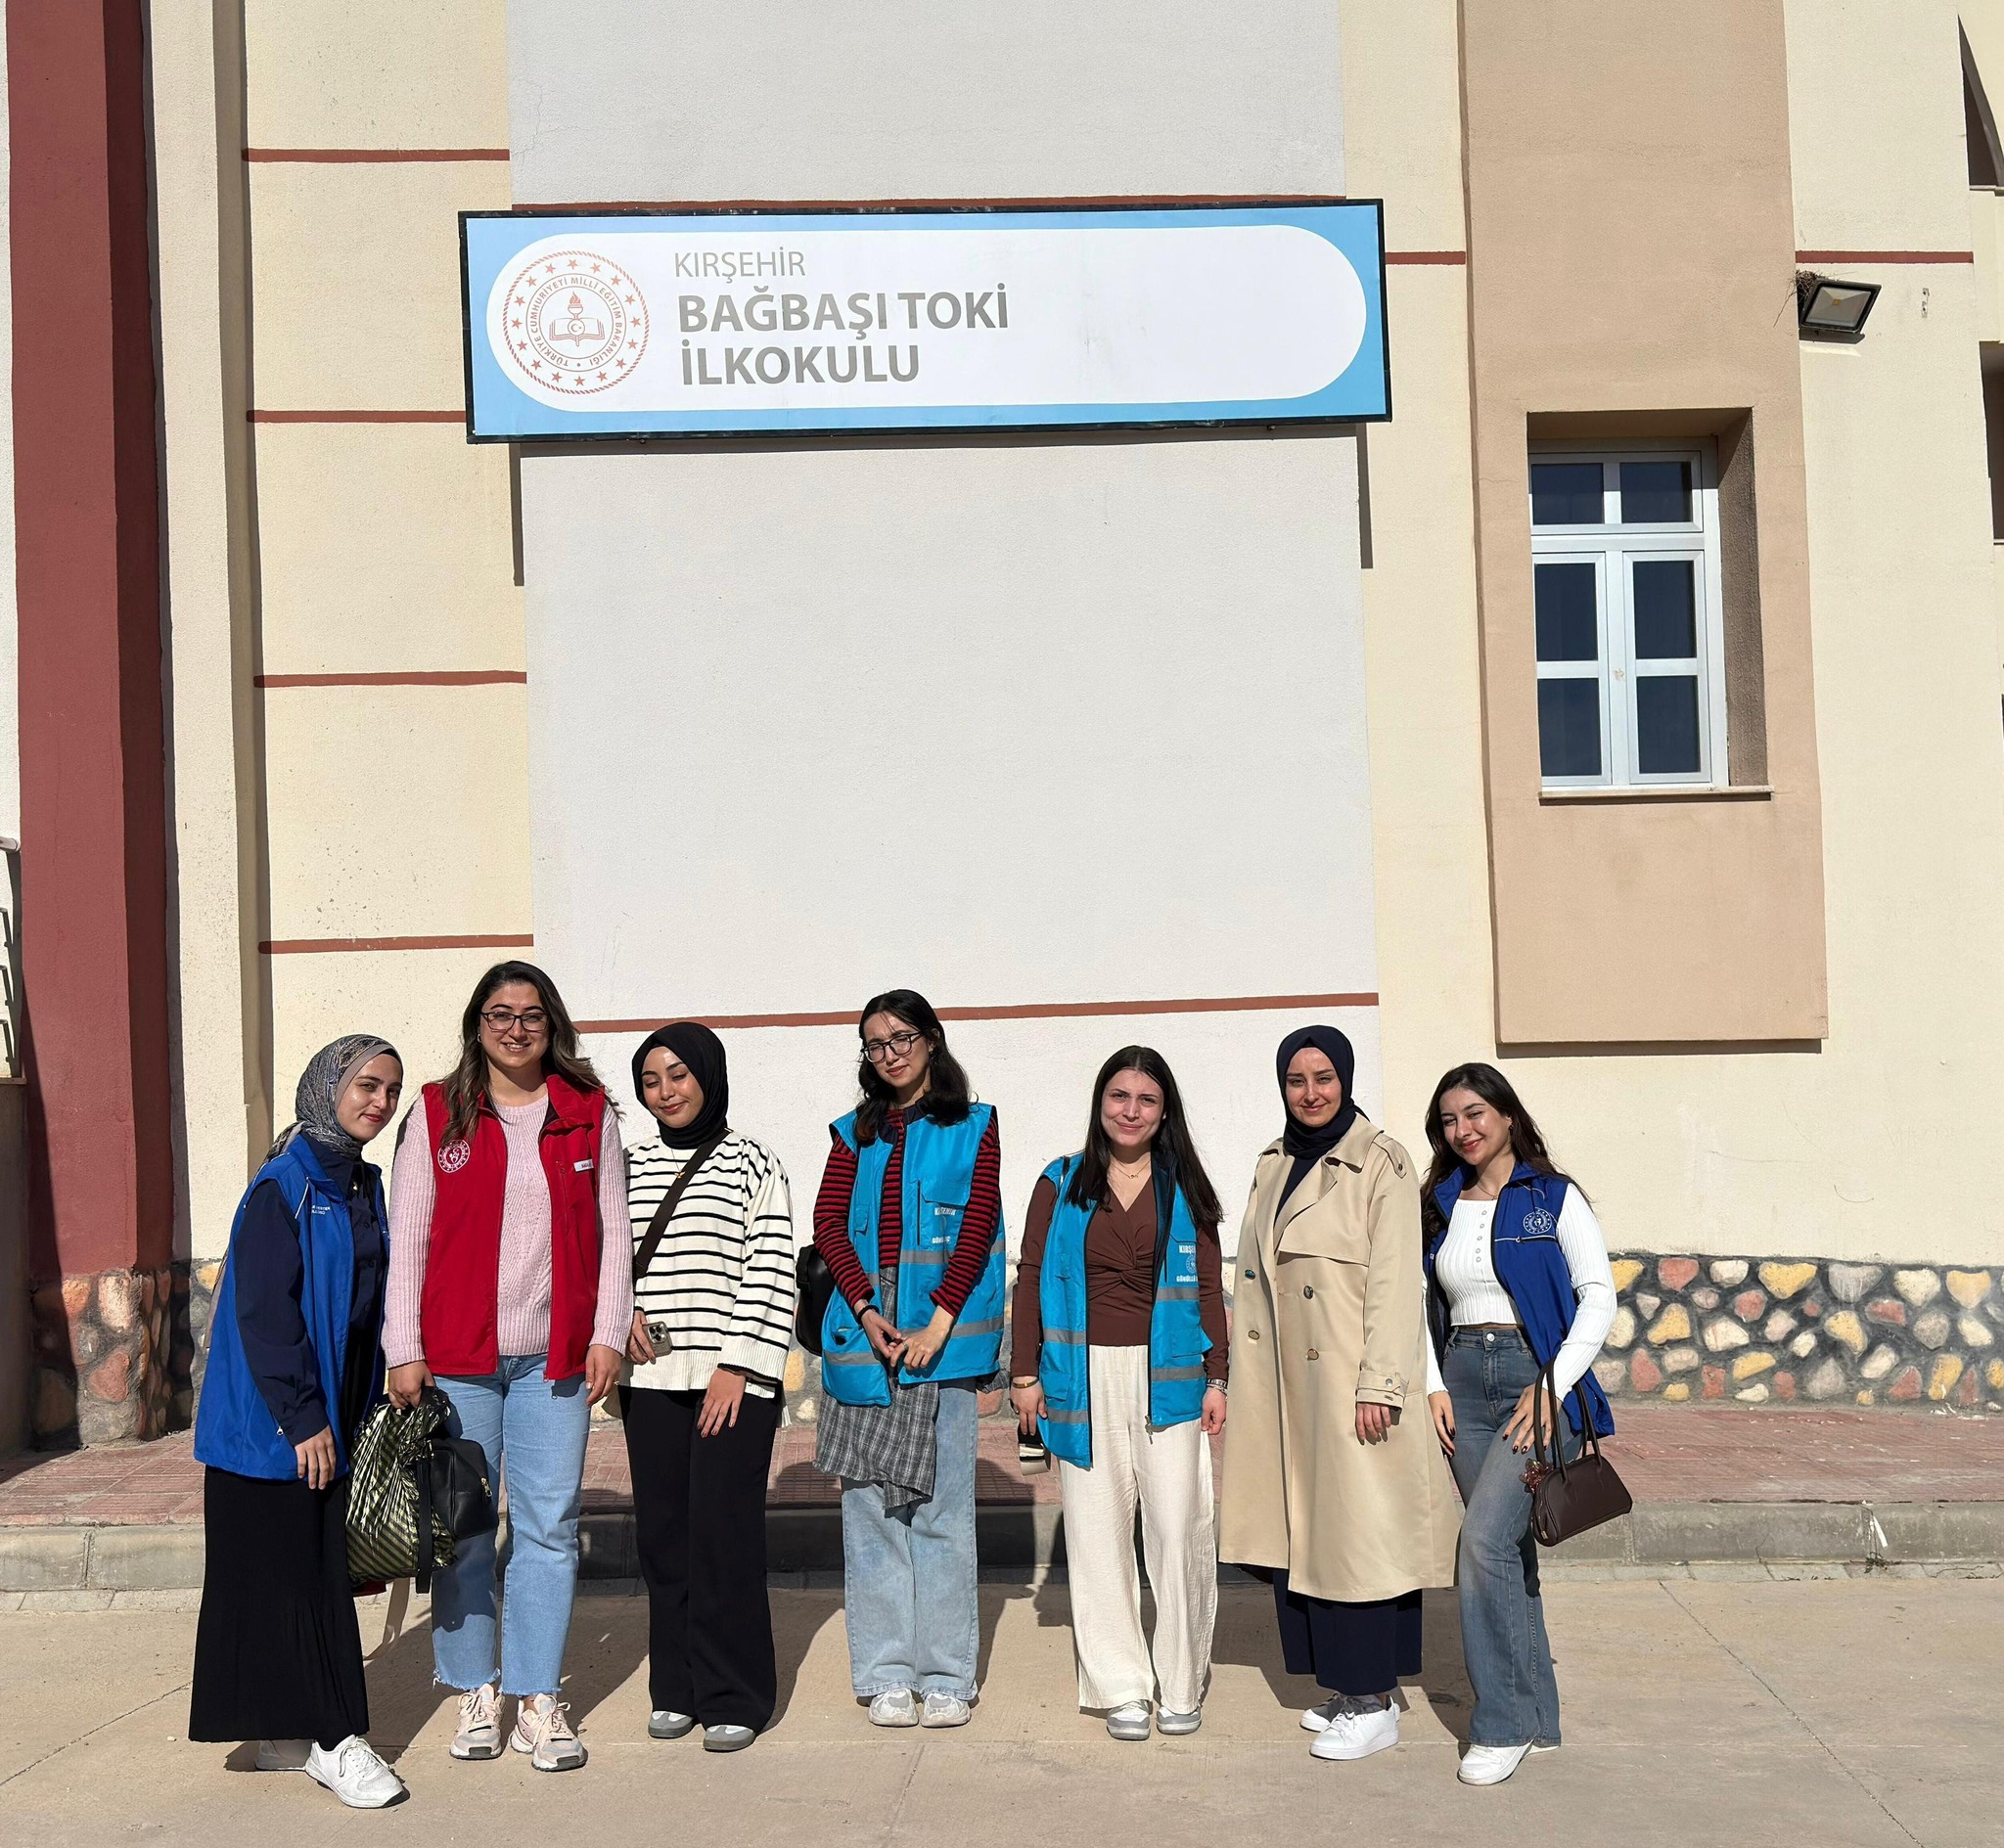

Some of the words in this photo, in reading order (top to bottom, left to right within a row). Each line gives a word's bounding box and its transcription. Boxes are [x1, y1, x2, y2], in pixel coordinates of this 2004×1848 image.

[570, 276, 598, 290] MİLLİ
[675, 247, 805, 283] KIRŞEHİR
[529, 277, 568, 333] CUMHURİYETİ
[599, 287, 621, 319] EĞİTİM
[678, 286, 888, 340] BAĞBAŞI
[897, 283, 1008, 330] TOKİ
[533, 336, 568, 366] TÜRKİYE
[589, 323, 622, 366] BAKANLIĞI
[681, 338, 919, 385] İLKOKULU
